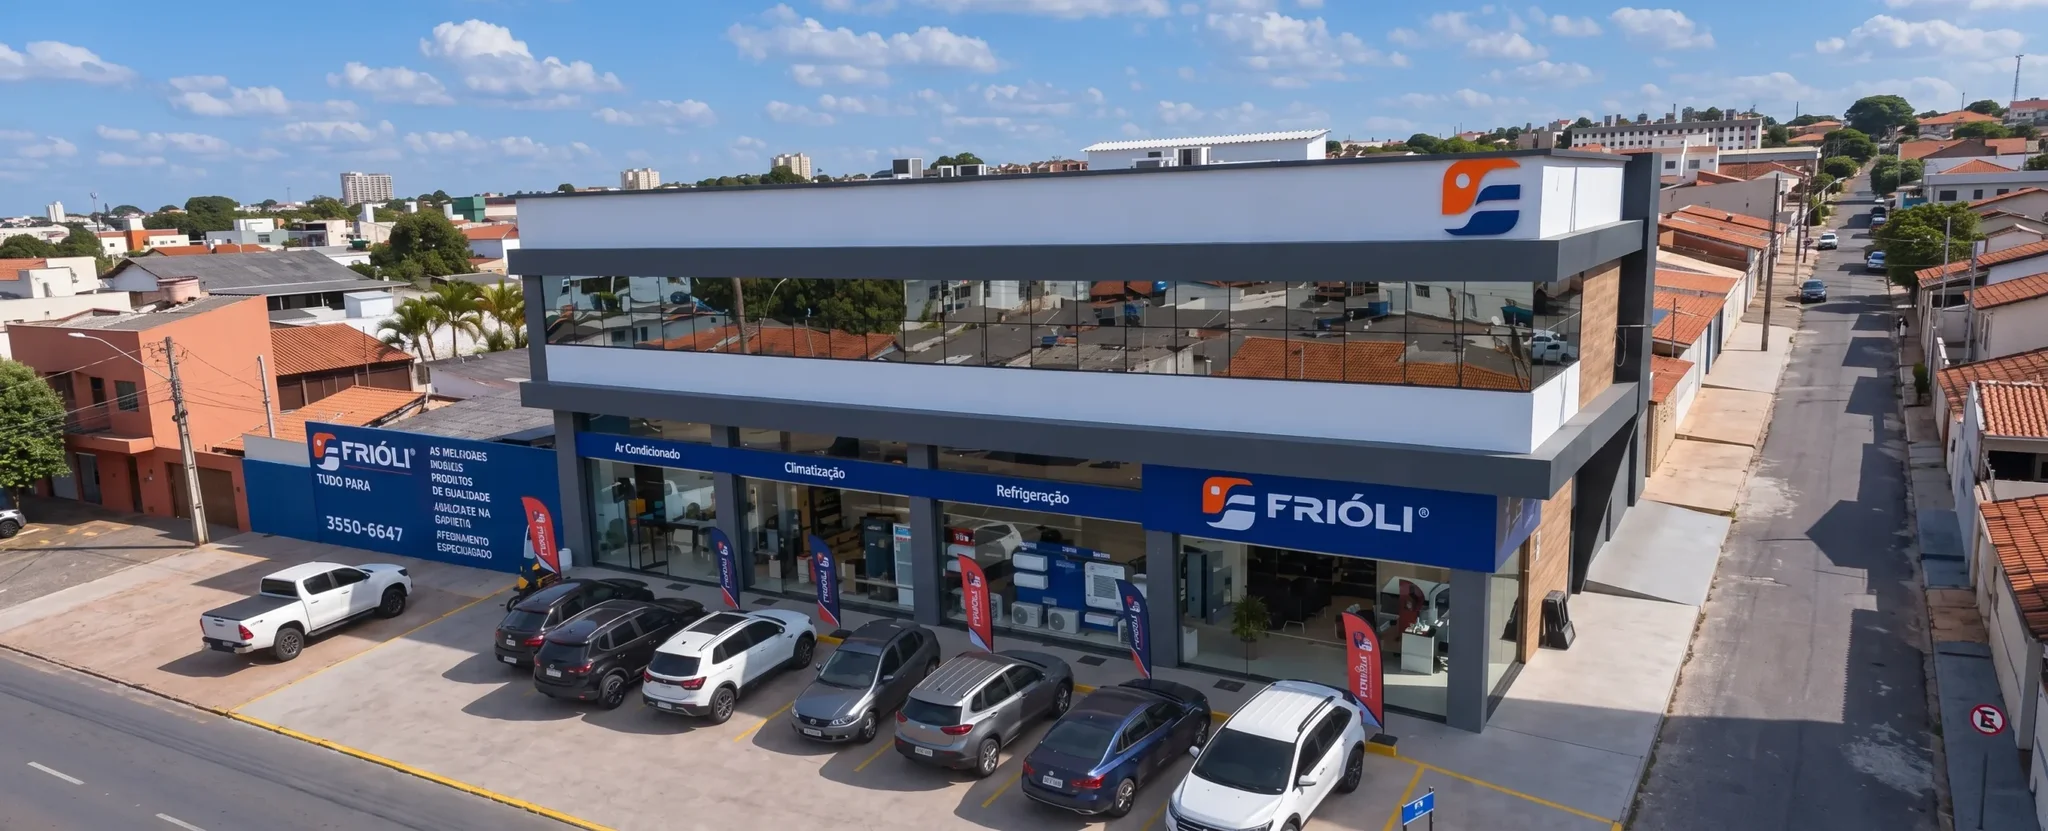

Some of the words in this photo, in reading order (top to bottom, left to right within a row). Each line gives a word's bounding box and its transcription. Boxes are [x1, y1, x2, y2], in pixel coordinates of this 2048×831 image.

[430, 446, 441, 456] AS
[615, 442, 624, 452] Ar
[625, 443, 680, 460] Condicionado
[784, 461, 846, 480] Climatização
[316, 473, 343, 487] TUDO
[345, 477, 371, 492] PARA
[432, 486, 443, 496] DE
[996, 484, 1070, 506] Refrigeração
[478, 507, 491, 518] NA
[326, 515, 403, 542] 3550-6647
